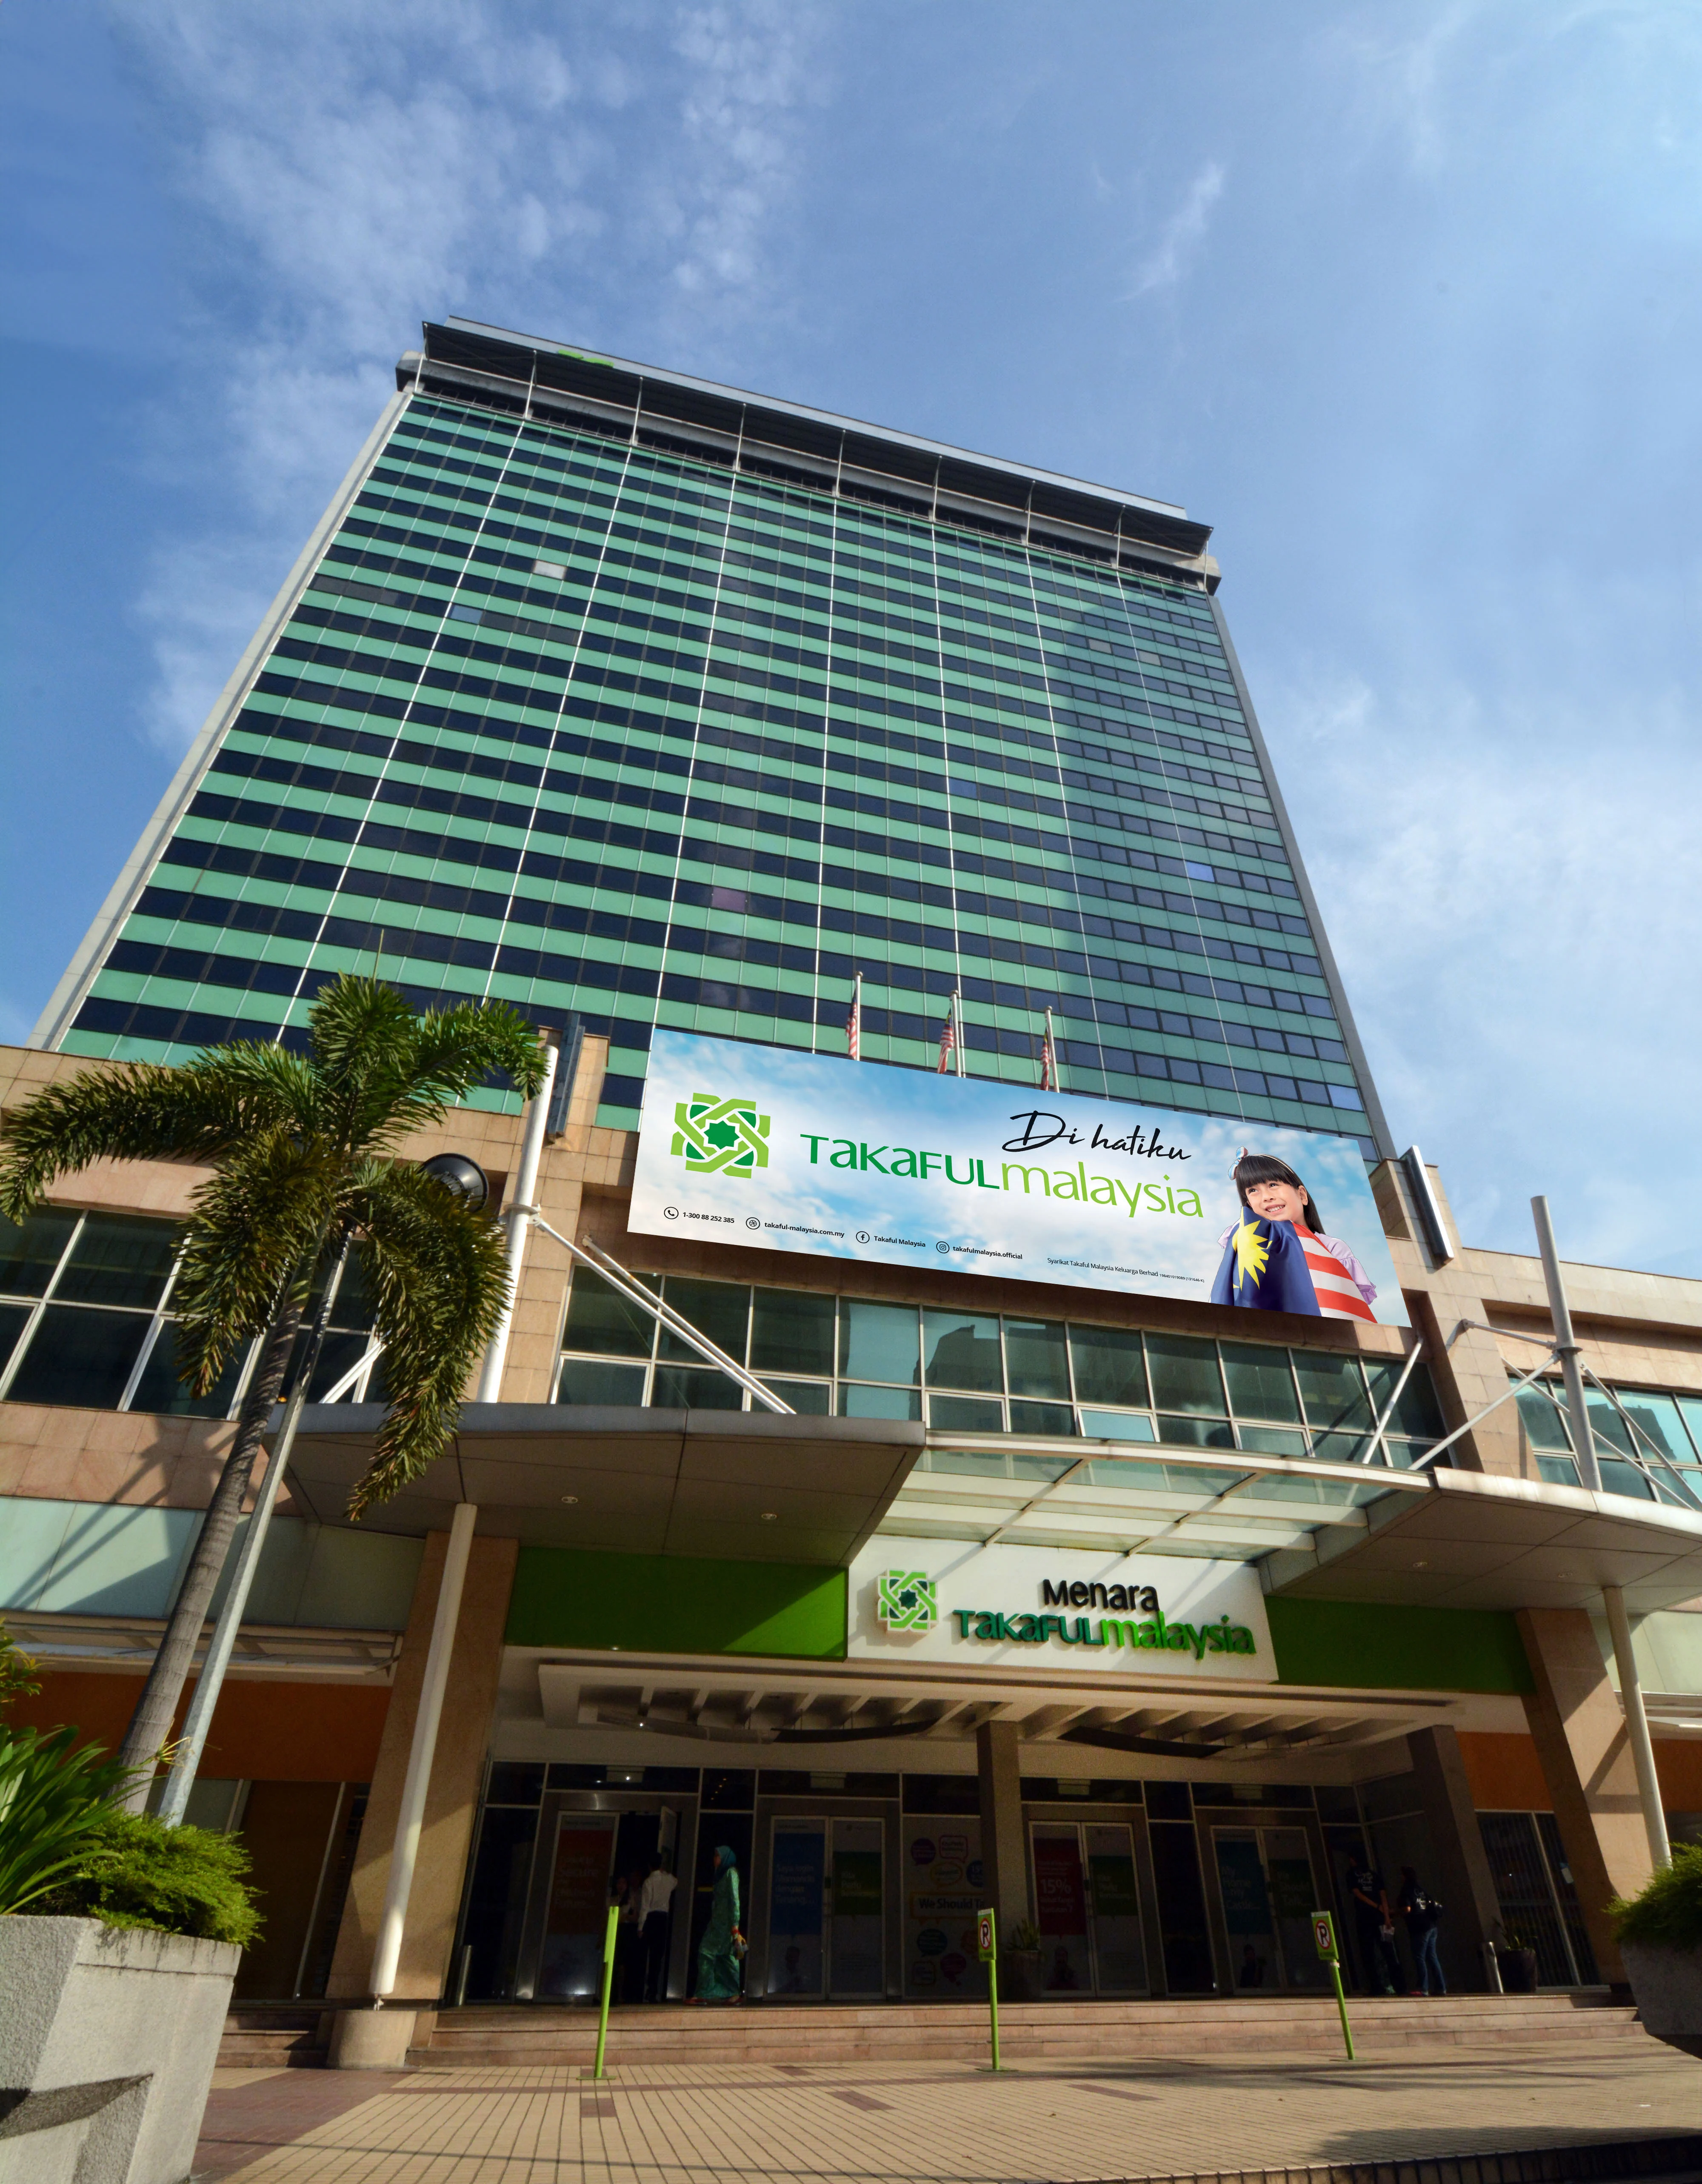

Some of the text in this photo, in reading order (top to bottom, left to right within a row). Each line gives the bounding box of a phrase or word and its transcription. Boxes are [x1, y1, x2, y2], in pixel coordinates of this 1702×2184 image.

[1002, 1110, 1191, 1160] Di hatiku
[764, 1222, 845, 1238] takaful-malaysia.com.my
[874, 1236, 926, 1248] Takaful Malaysia
[953, 1245, 1022, 1259] takafulmalaysia.official
[1091, 1263, 1114, 1271] Malaysia
[1115, 1266, 1138, 1275] Keluarga
[1042, 1579, 1160, 1613] Menara
[1040, 1878, 1072, 1894] 15%
